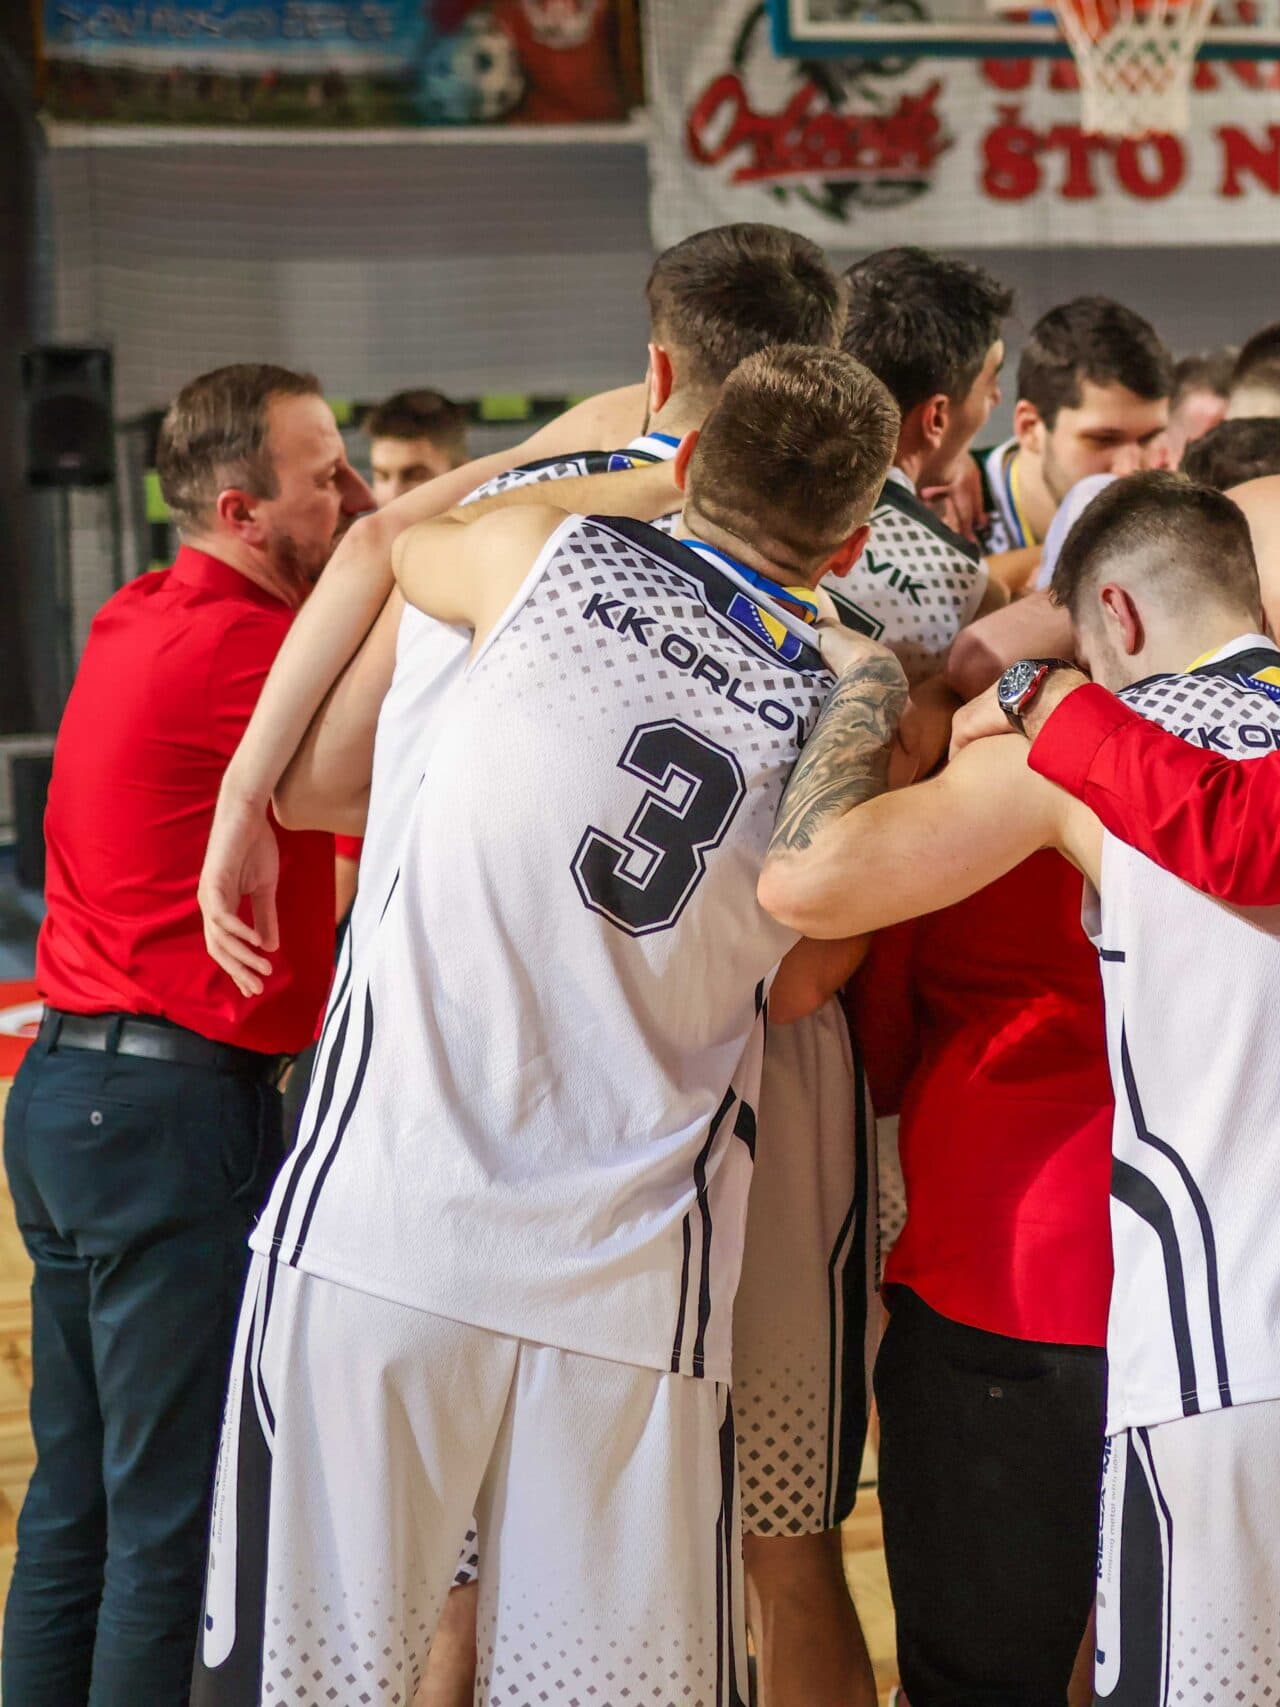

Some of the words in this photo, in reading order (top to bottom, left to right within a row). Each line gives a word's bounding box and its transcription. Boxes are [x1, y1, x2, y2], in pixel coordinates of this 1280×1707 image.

[981, 105, 1187, 201] ŠTO
[582, 593, 659, 647] KK
[1168, 725, 1233, 750] K
[570, 718, 748, 938] 3
